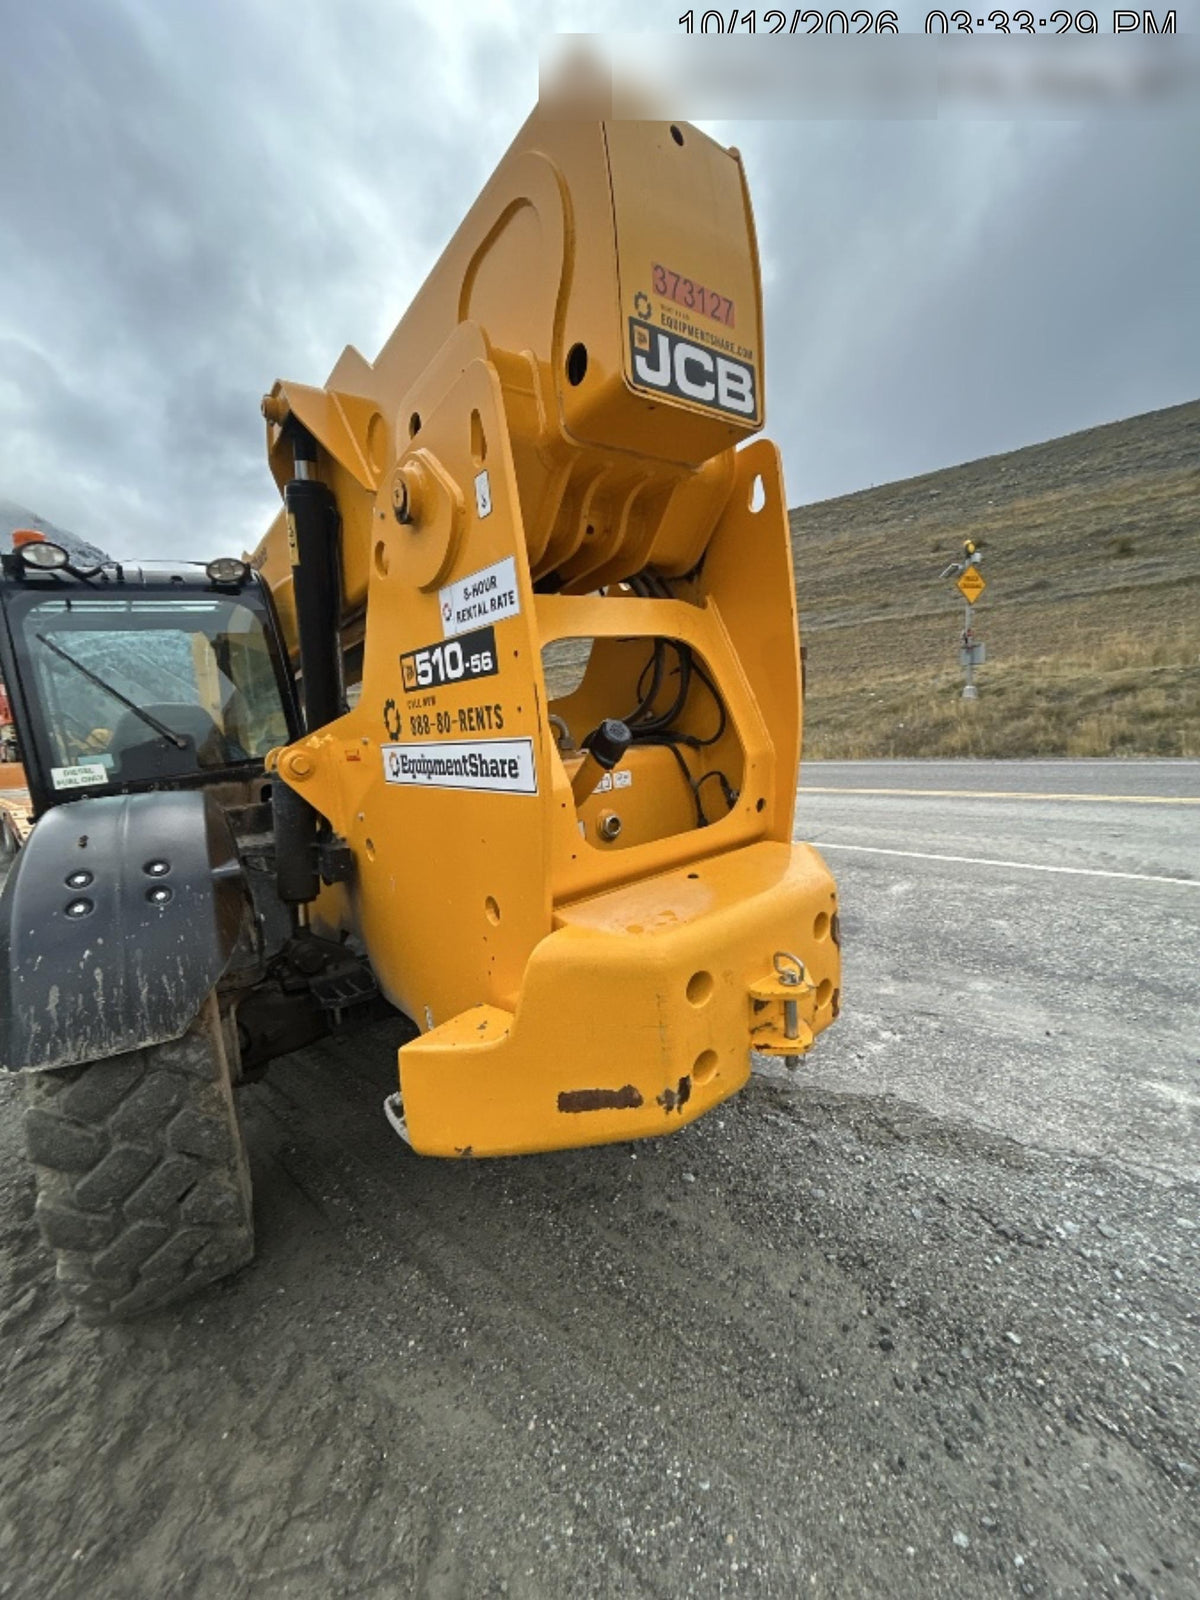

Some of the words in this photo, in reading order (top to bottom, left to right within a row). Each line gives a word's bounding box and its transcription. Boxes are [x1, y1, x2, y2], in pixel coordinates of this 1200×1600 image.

[654, 264, 734, 325] 373127
[635, 334, 755, 413] JCB
[456, 602, 489, 624] RENTAL
[490, 590, 515, 612] RATE
[410, 703, 504, 736] 888-80-RENTS
[400, 753, 520, 780] EquipmentShare
